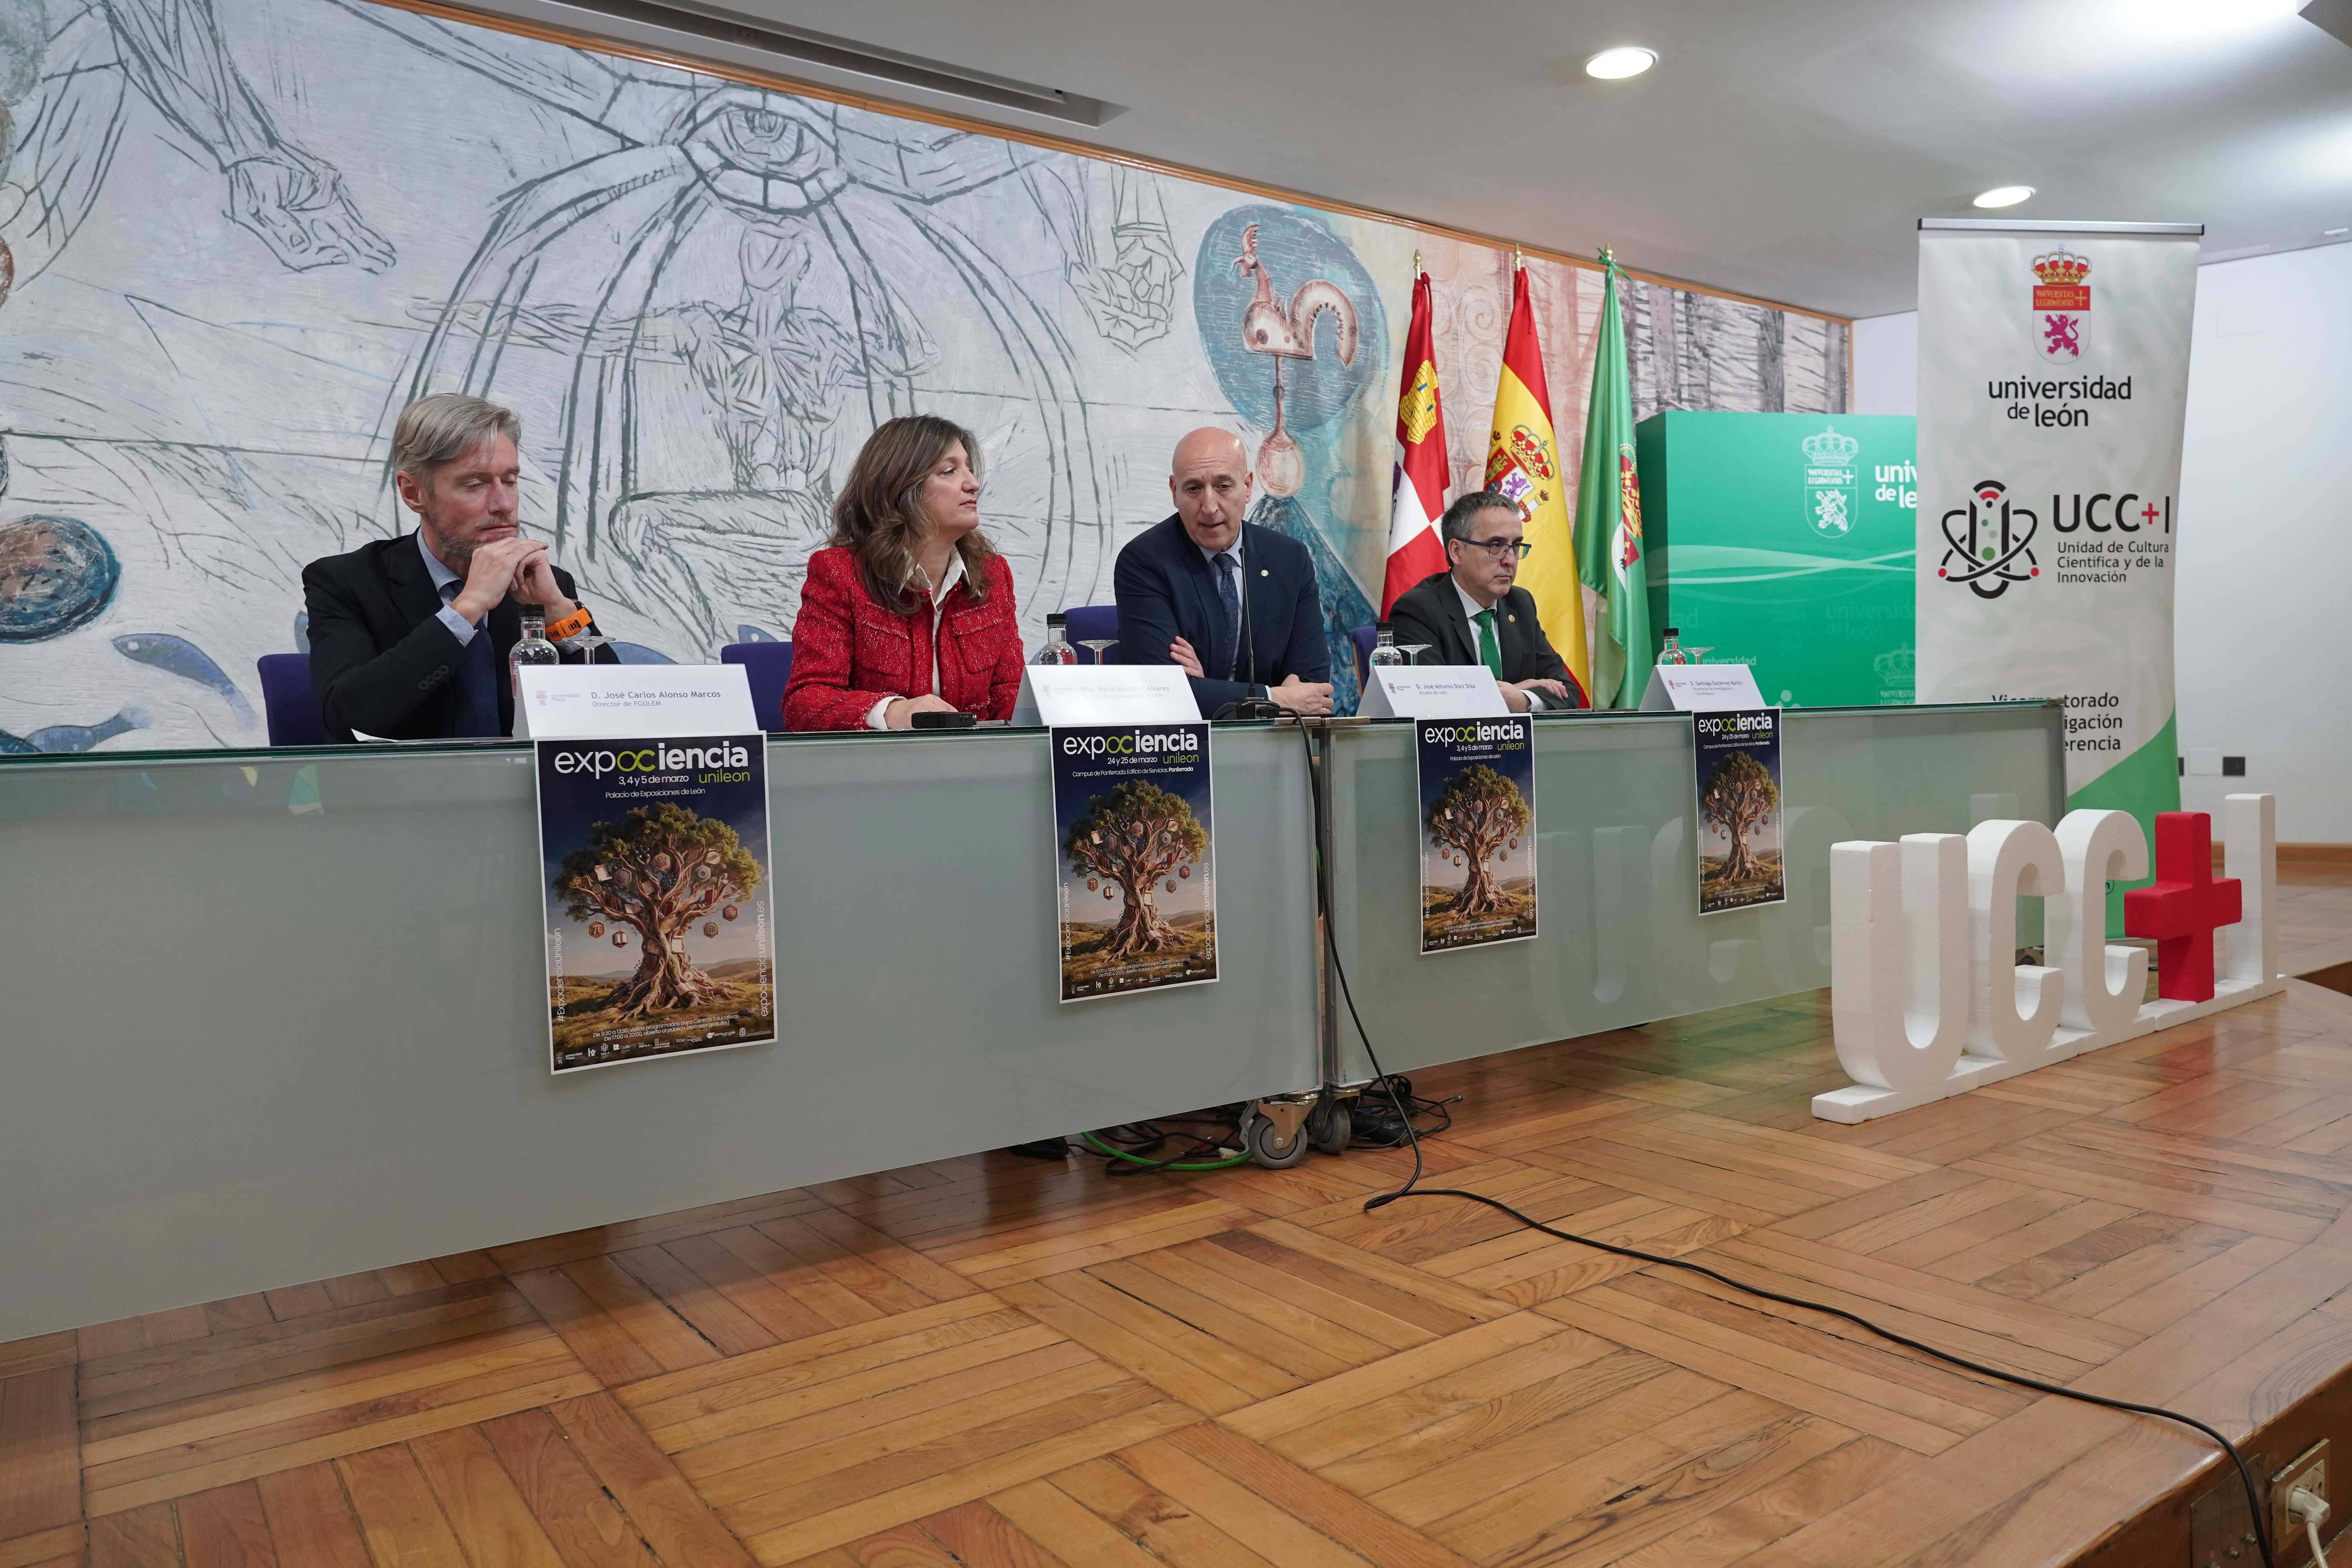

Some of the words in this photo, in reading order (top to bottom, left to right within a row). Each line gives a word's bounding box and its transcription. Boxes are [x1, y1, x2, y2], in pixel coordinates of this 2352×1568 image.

[1989, 375, 2131, 399] universidad
[2008, 402, 2029, 419] de
[2036, 403, 2088, 426] león
[1875, 484, 1896, 501] de
[2058, 542, 2102, 553] Unidad
[2108, 541, 2123, 552] de
[2129, 541, 2168, 552] Cultura
[2058, 556, 2118, 568] Científica
[2125, 559, 2131, 570] y
[2136, 556, 2150, 567] de
[2155, 556, 2163, 567] la
[2058, 571, 2126, 583] Innovación
[1703, 655, 1756, 666] niversidad
[1699, 713, 1772, 736] expociencia
[1425, 720, 1523, 747] expociencia
[1752, 731, 1773, 739] unileon
[1063, 729, 1198, 759] expociencia
[1497, 740, 1524, 751] unileon
[555, 741, 748, 779] expociencia
[1163, 752, 1199, 764] unileon
[634, 778, 640, 786] y
[699, 769, 750, 783] unileon
[756, 901, 771, 1016] expociencia.unileon.es
[554, 928, 565, 1022] #ExpocienciaUnileon
